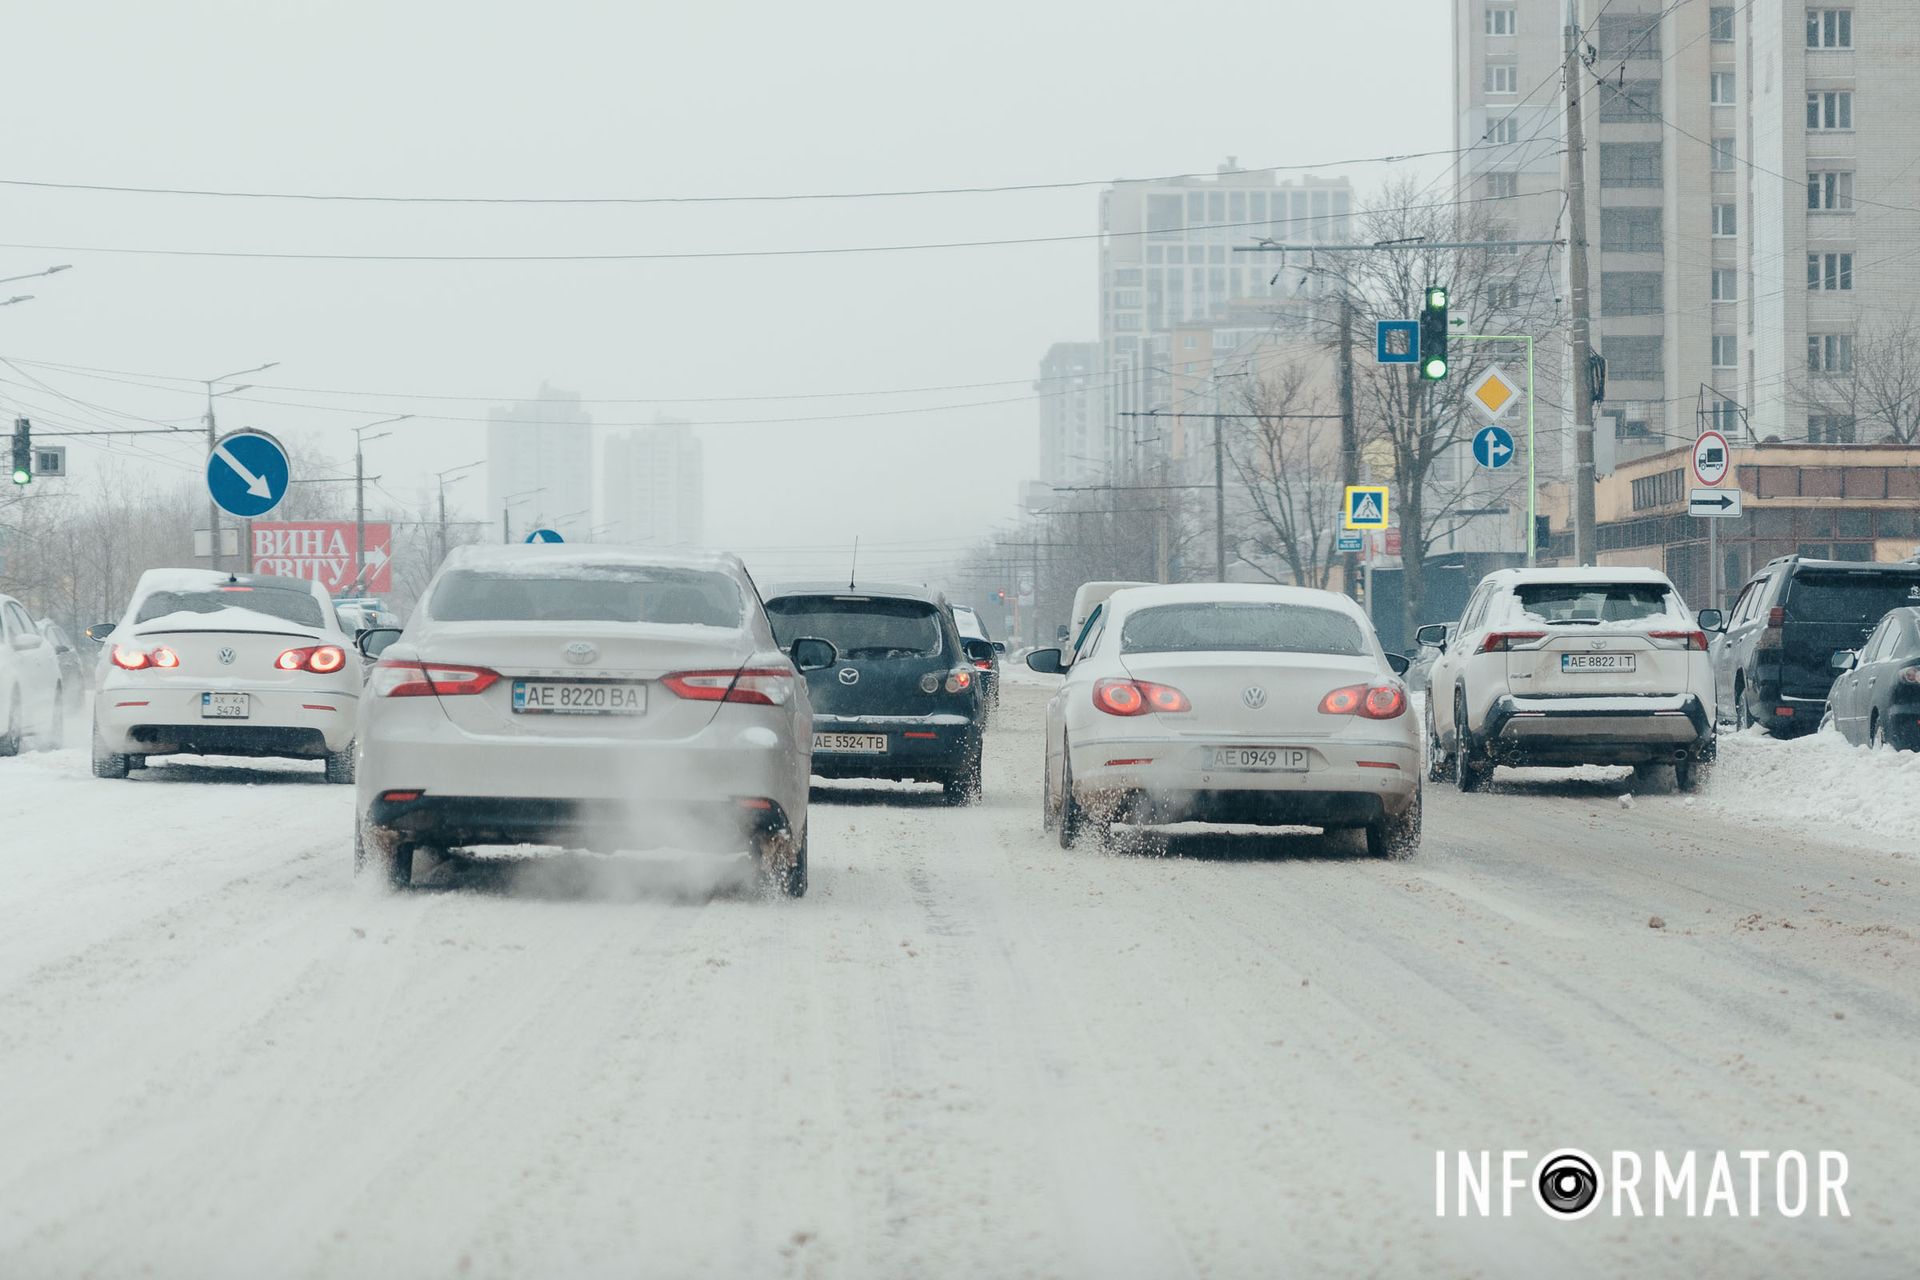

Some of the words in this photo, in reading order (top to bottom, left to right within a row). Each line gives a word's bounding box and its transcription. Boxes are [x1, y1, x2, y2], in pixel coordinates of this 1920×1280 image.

[253, 529, 349, 556] ВИНА
[254, 558, 349, 585] СВІТУ
[1570, 656, 1586, 667] AE
[1588, 656, 1615, 667] 8822
[1619, 656, 1633, 667] IT
[527, 687, 555, 706] AE
[560, 687, 606, 707] 8220
[610, 688, 638, 708] BA
[216, 705, 241, 716] 5478
[814, 735, 832, 748] AE
[835, 735, 864, 749] 5524
[866, 736, 884, 749] TB
[1214, 750, 1237, 766] AE
[1240, 750, 1277, 766] 0949
[1284, 751, 1304, 766] IP
